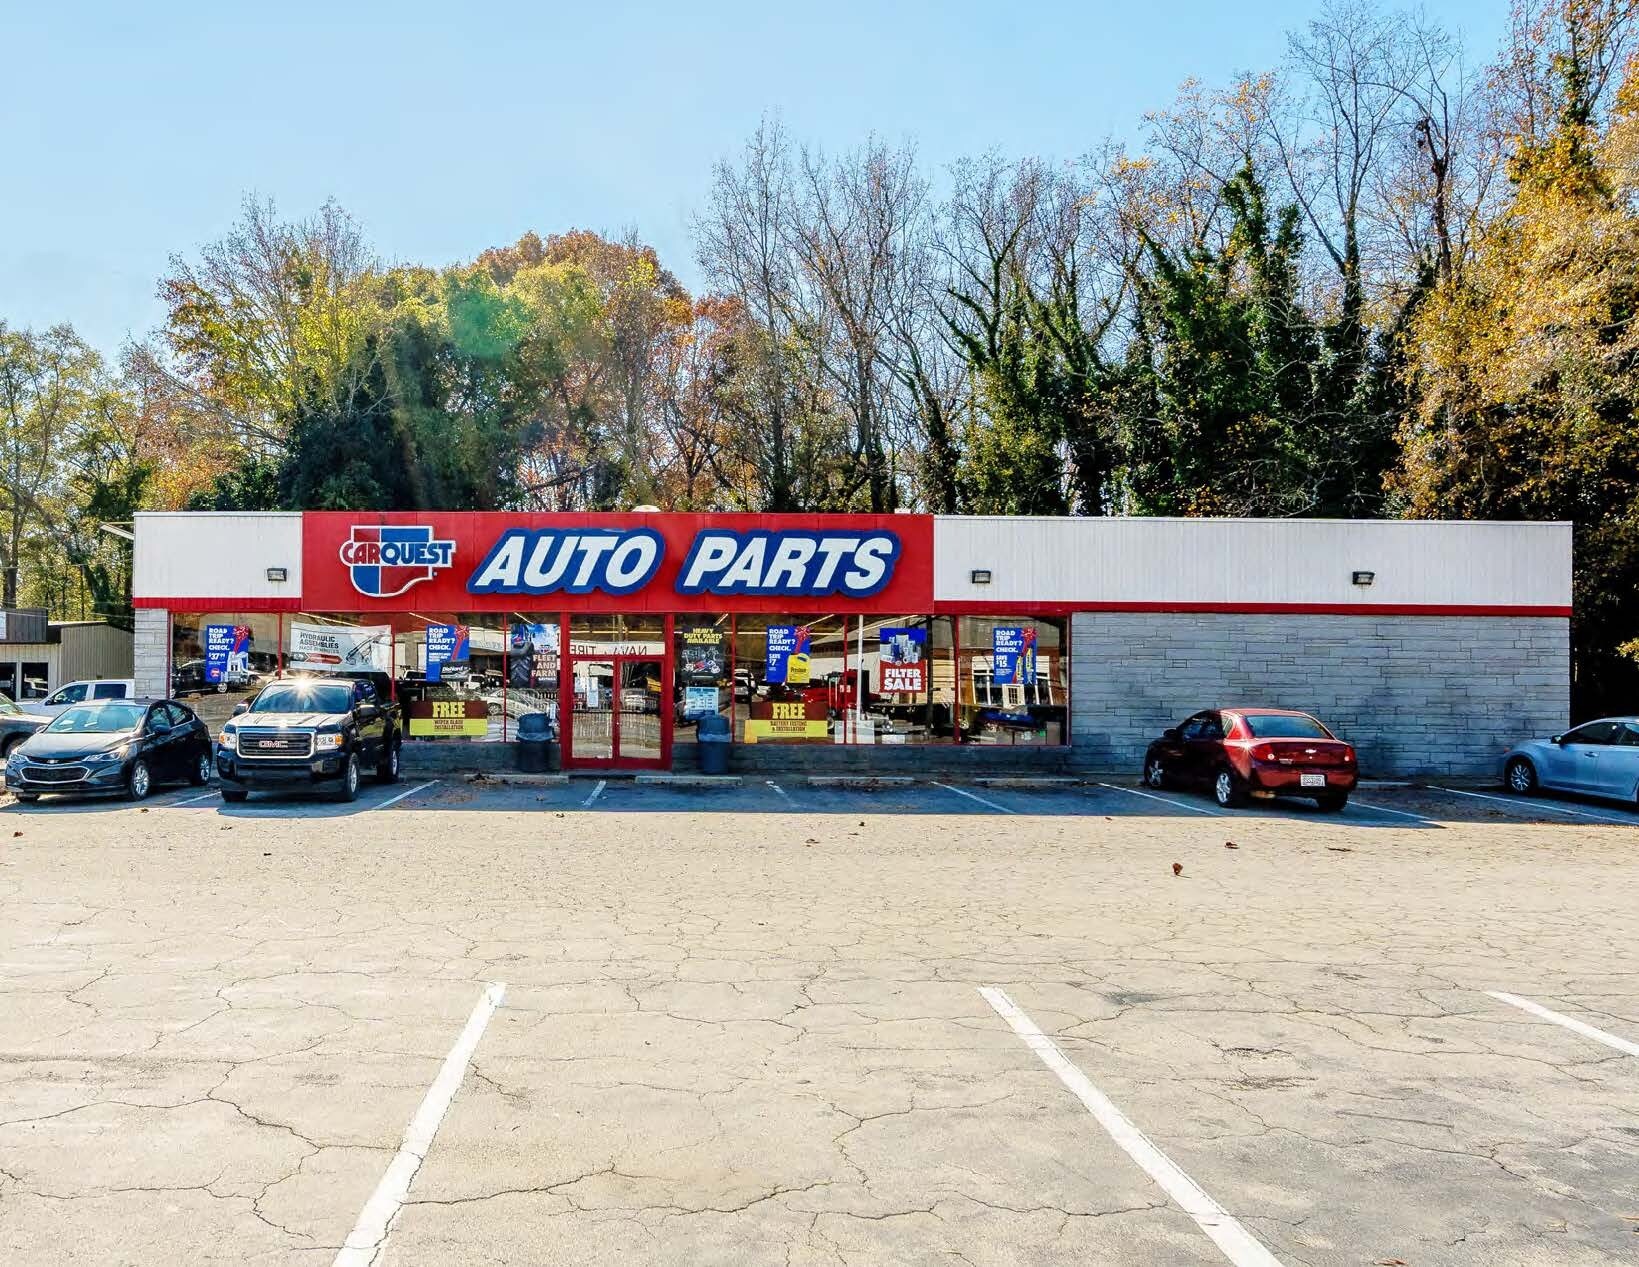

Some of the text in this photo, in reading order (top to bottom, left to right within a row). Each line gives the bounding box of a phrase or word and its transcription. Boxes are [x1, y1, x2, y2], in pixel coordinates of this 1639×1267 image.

[342, 542, 453, 566] CARQUEST
[475, 536, 892, 589] AUTO PARTS
[300, 632, 336, 643] HYDRAULIC
[299, 639, 339, 649] ASSEMBLIES
[536, 661, 556, 669] AND
[531, 669, 556, 677] FARM
[884, 668, 922, 678] FILTER
[883, 678, 922, 690] SALE
[432, 701, 465, 718] FREE
[772, 703, 806, 719] FREE
[258, 740, 289, 748] GMC
